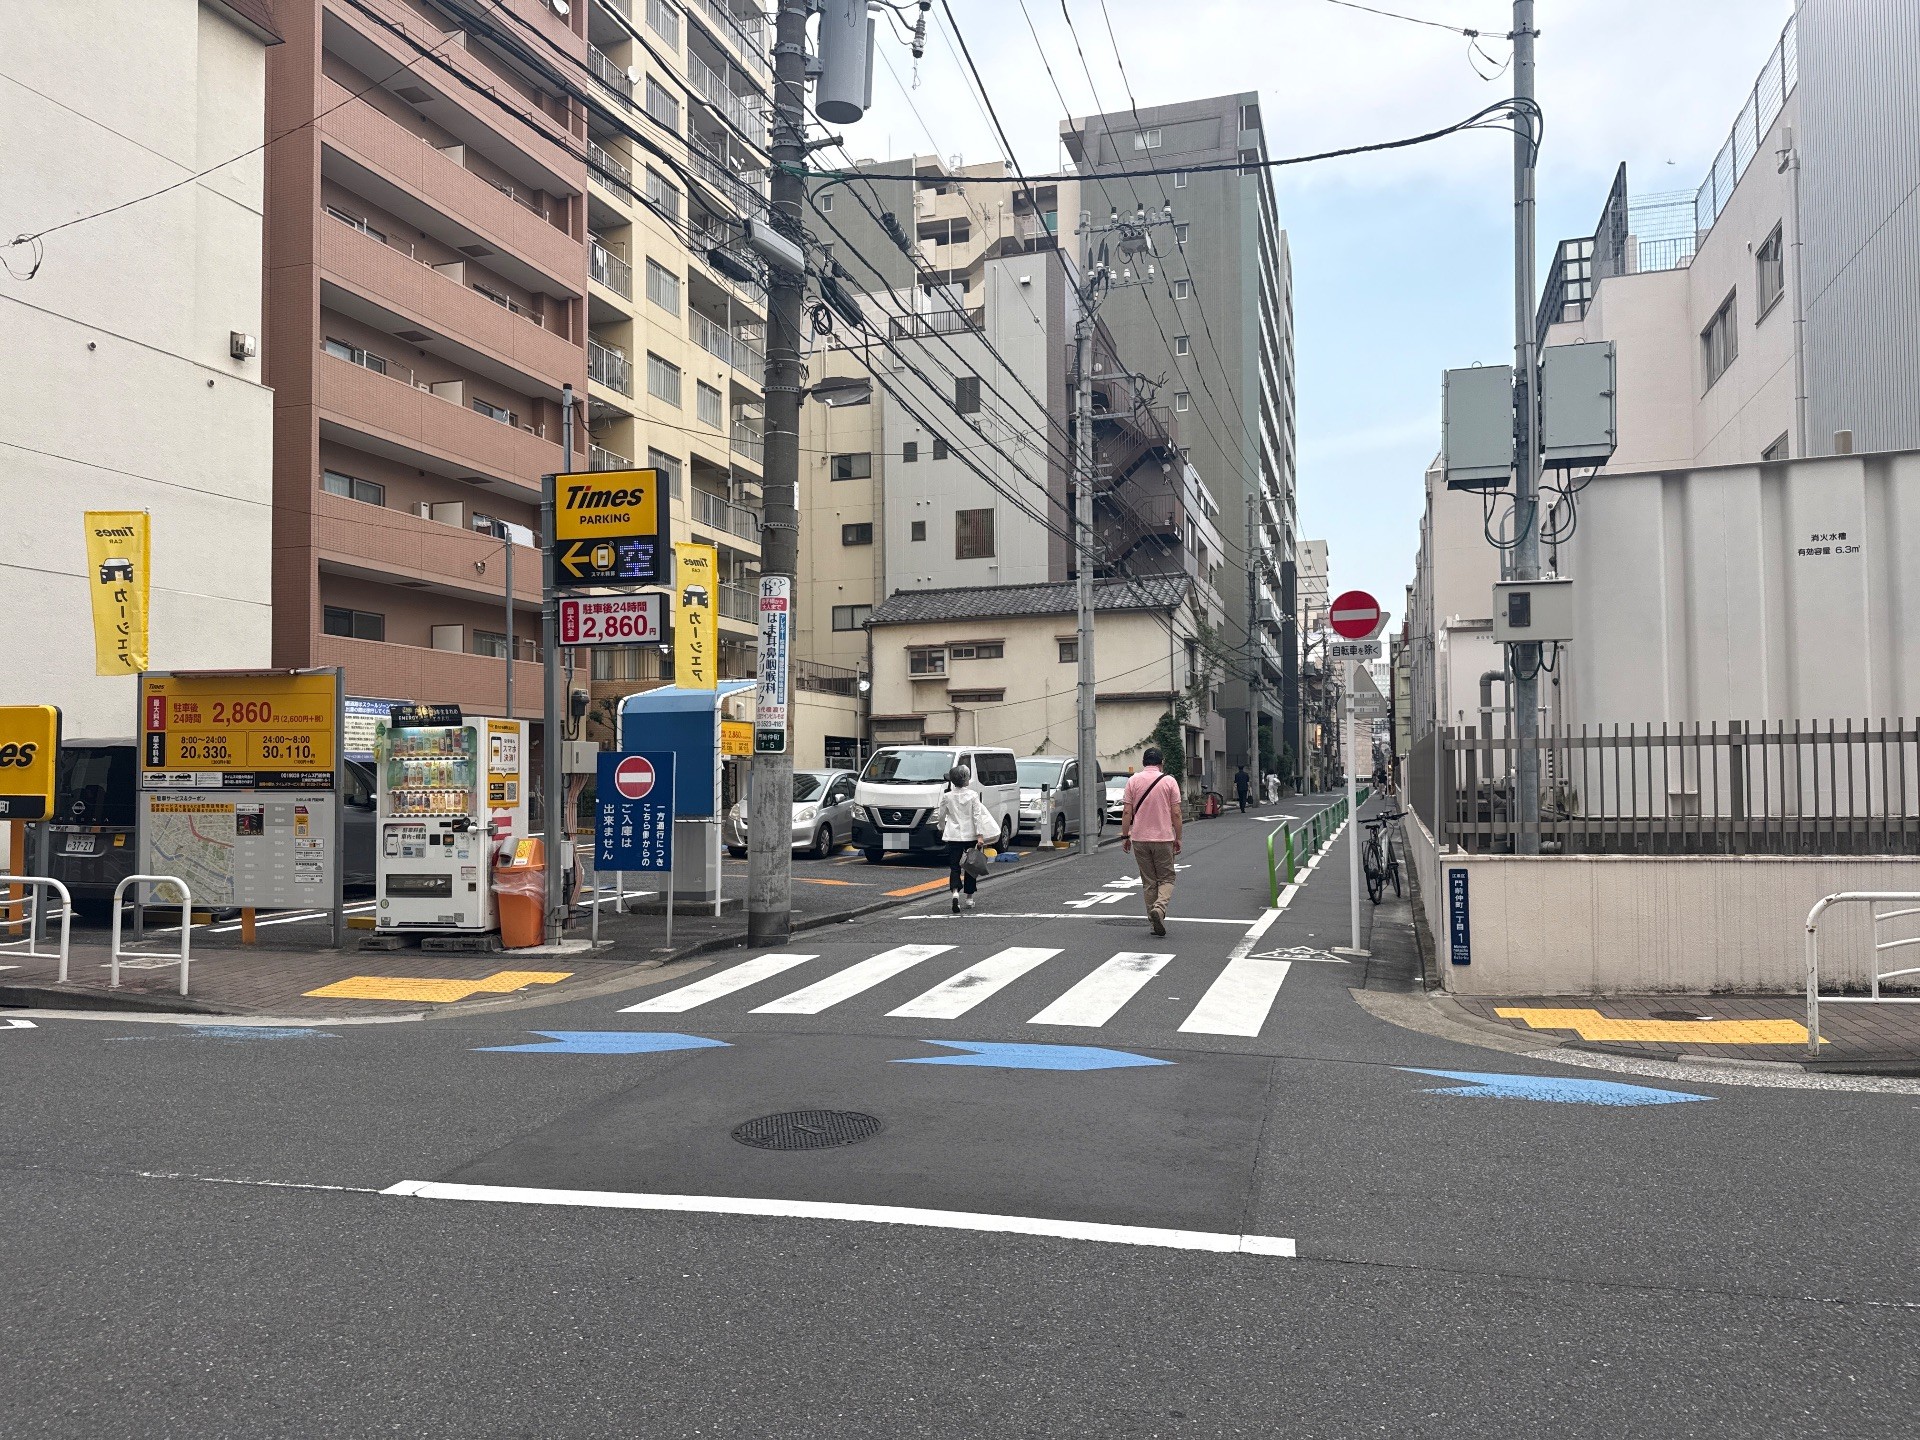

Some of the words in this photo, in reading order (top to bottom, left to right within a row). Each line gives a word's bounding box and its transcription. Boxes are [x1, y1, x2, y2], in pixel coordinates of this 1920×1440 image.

[566, 485, 644, 510] Times
[580, 513, 630, 525] PARKING
[1811, 532, 1846, 542] 消火水槽
[619, 540, 654, 577] 空
[1798, 546, 1831, 557] 有効容量
[582, 601, 647, 615] 駐車後24時間
[566, 607, 575, 637] 最大料金
[1332, 644, 1379, 656] 自転車を除く
[757, 652, 766, 705] クリニック
[173, 702, 199, 713] 駐車後
[173, 714, 202, 724] 24時間
[602, 803, 615, 860] 出来ません
[621, 803, 634, 848] ご入庫は
[642, 803, 651, 867] こちら側からの
[656, 805, 666, 867] 一方通行につき
[1454, 880, 1464, 930] 門前仲町一丁目
[1458, 933, 1463, 943] 1
